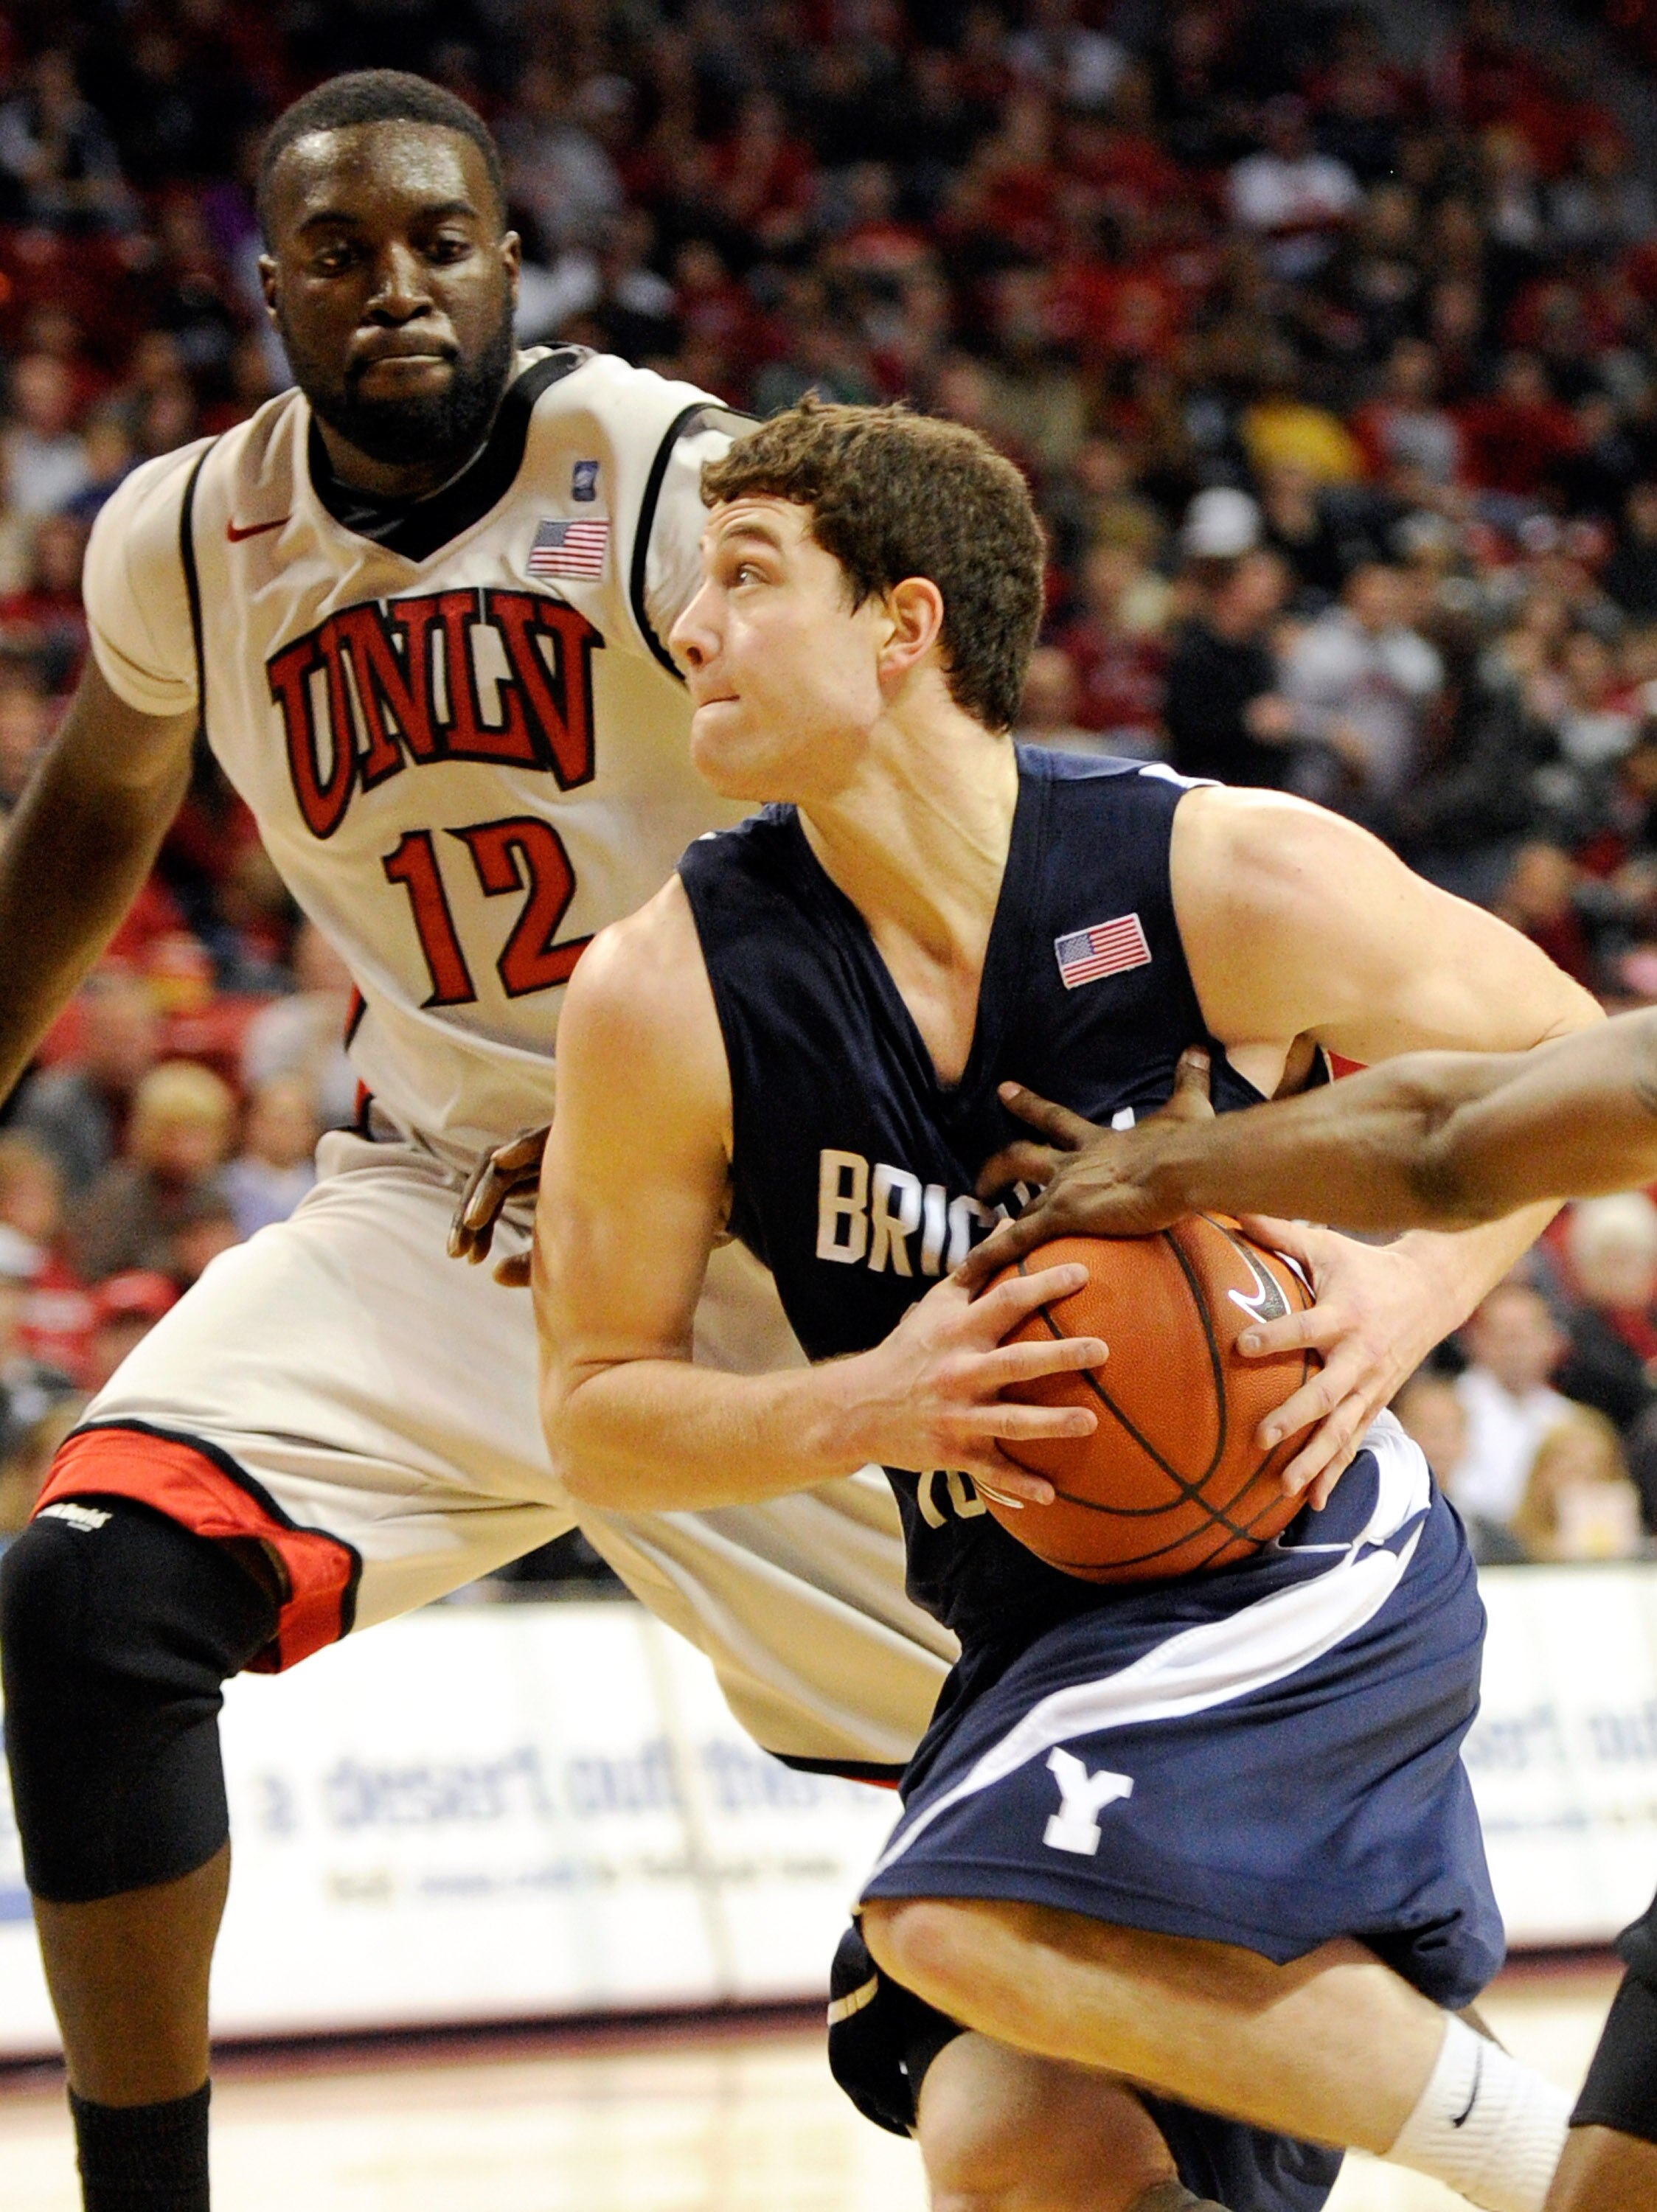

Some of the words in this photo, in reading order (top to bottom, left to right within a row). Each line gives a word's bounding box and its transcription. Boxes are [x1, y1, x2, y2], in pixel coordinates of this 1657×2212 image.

[266, 587, 605, 839] UNLV
[383, 815, 595, 1009] 12
[1042, 1746, 1133, 1856] Y
